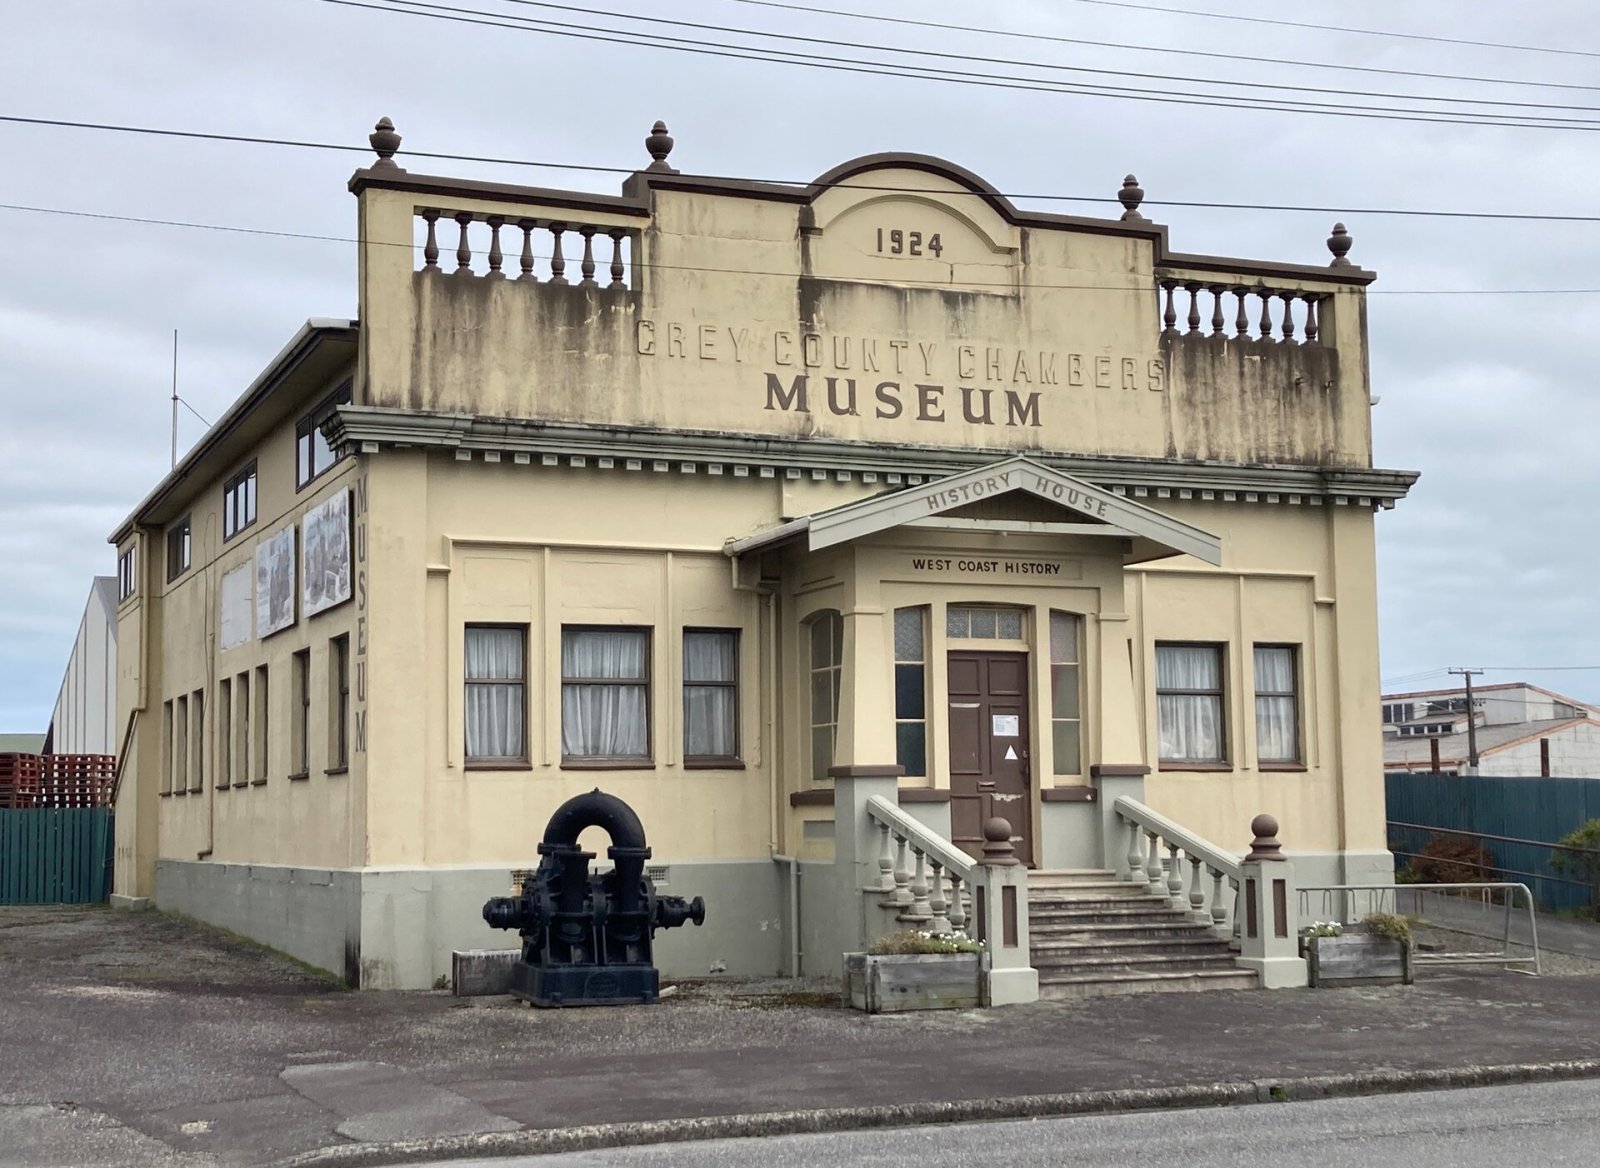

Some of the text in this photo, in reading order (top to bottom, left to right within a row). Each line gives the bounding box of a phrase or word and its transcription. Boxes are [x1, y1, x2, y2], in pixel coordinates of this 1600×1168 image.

[877, 228, 943, 258] 1924
[636, 319, 1165, 392] GREY COUNTY CHAMBERS
[763, 372, 1043, 427] MUSEUM
[927, 474, 1108, 517] HISTORY HOUSE
[912, 558, 1061, 575] WEST COAST HISTORY
[355, 474, 368, 752] MUSEUM
